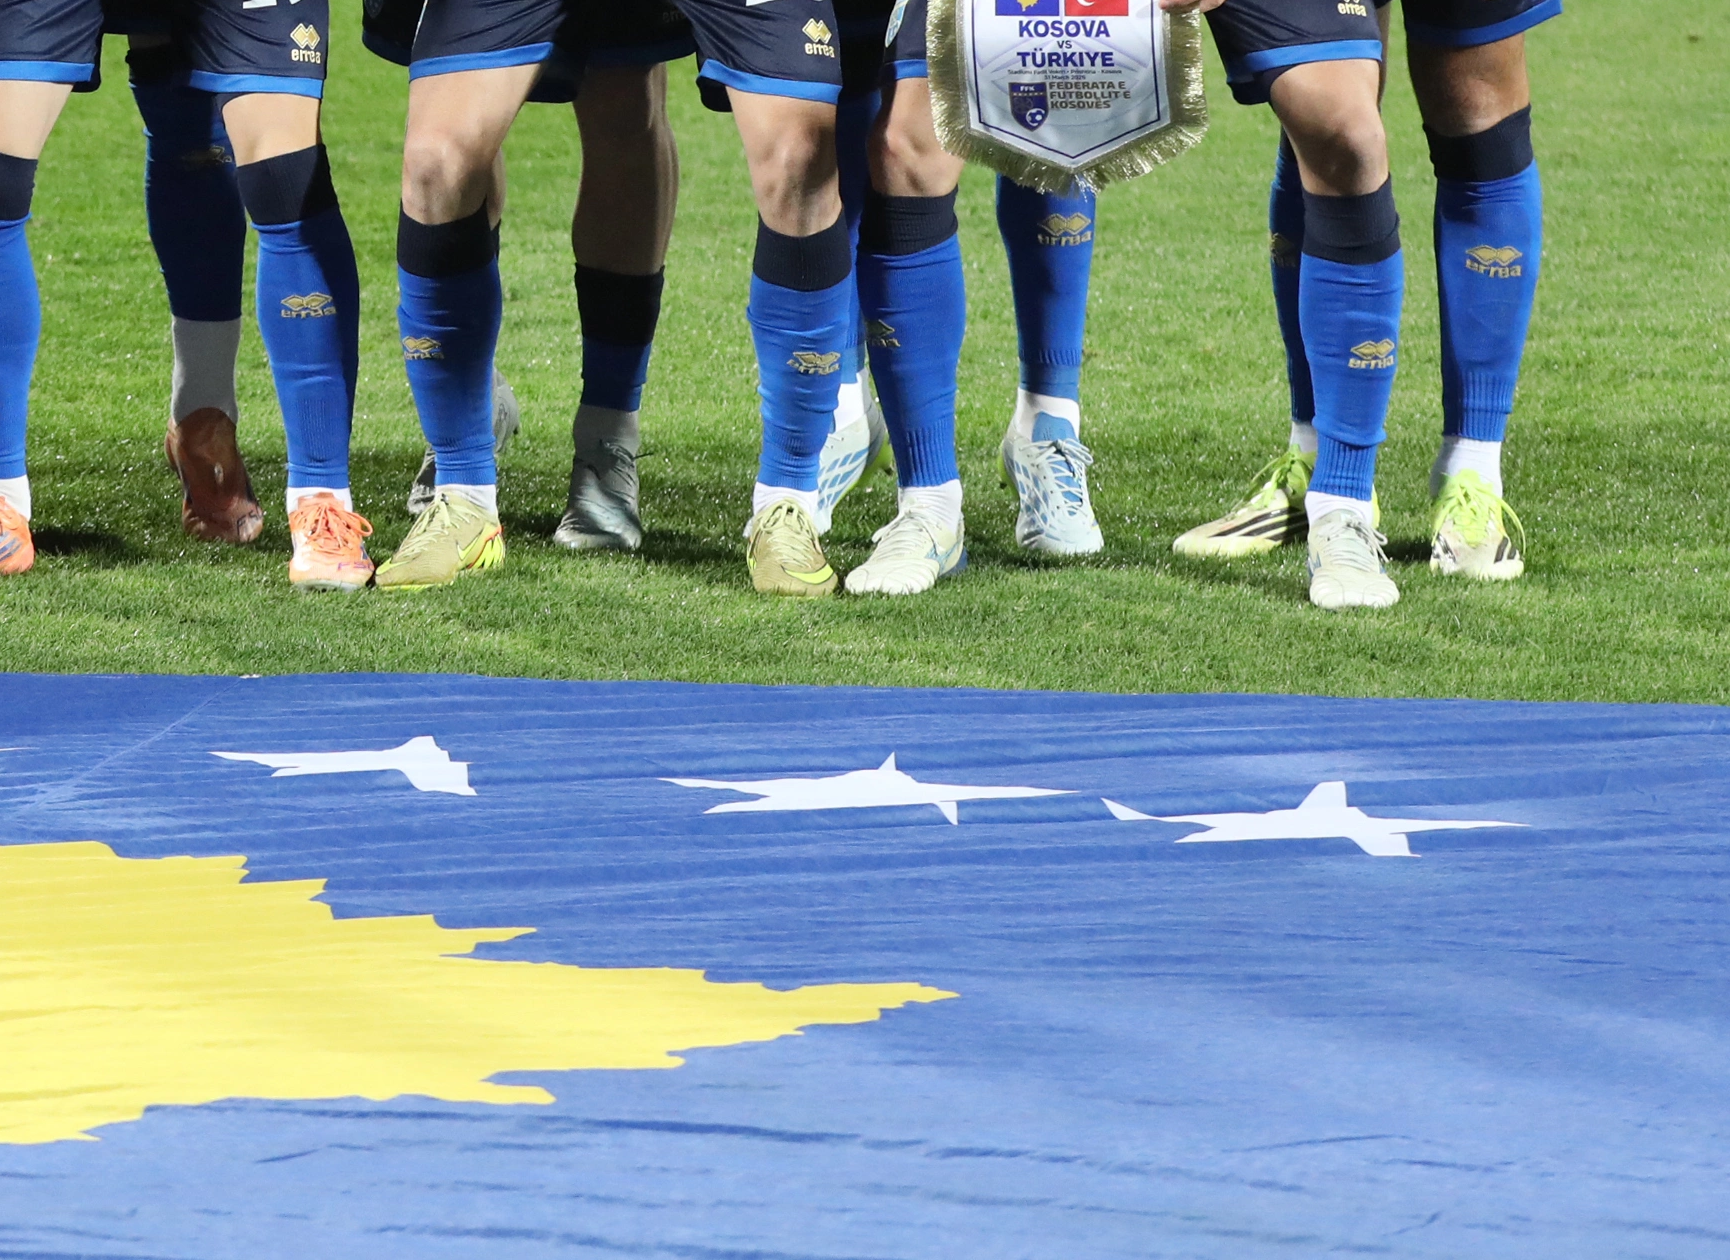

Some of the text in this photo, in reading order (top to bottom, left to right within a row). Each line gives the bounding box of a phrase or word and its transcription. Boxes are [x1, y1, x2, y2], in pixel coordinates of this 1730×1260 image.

[1337, 2, 1367, 17] errea
[1018, 20, 1110, 38] KOSOVA
[804, 42, 835, 58] errea
[1057, 40, 1072, 49] VS
[291, 48, 321, 64] errea
[1016, 47, 1115, 68] TÜRKIYE
[1049, 81, 1127, 90] FEDERATA E
[1050, 91, 1131, 100] FUTBOLLIT E
[1465, 258, 1522, 279] errea
[1347, 355, 1395, 370] errea
